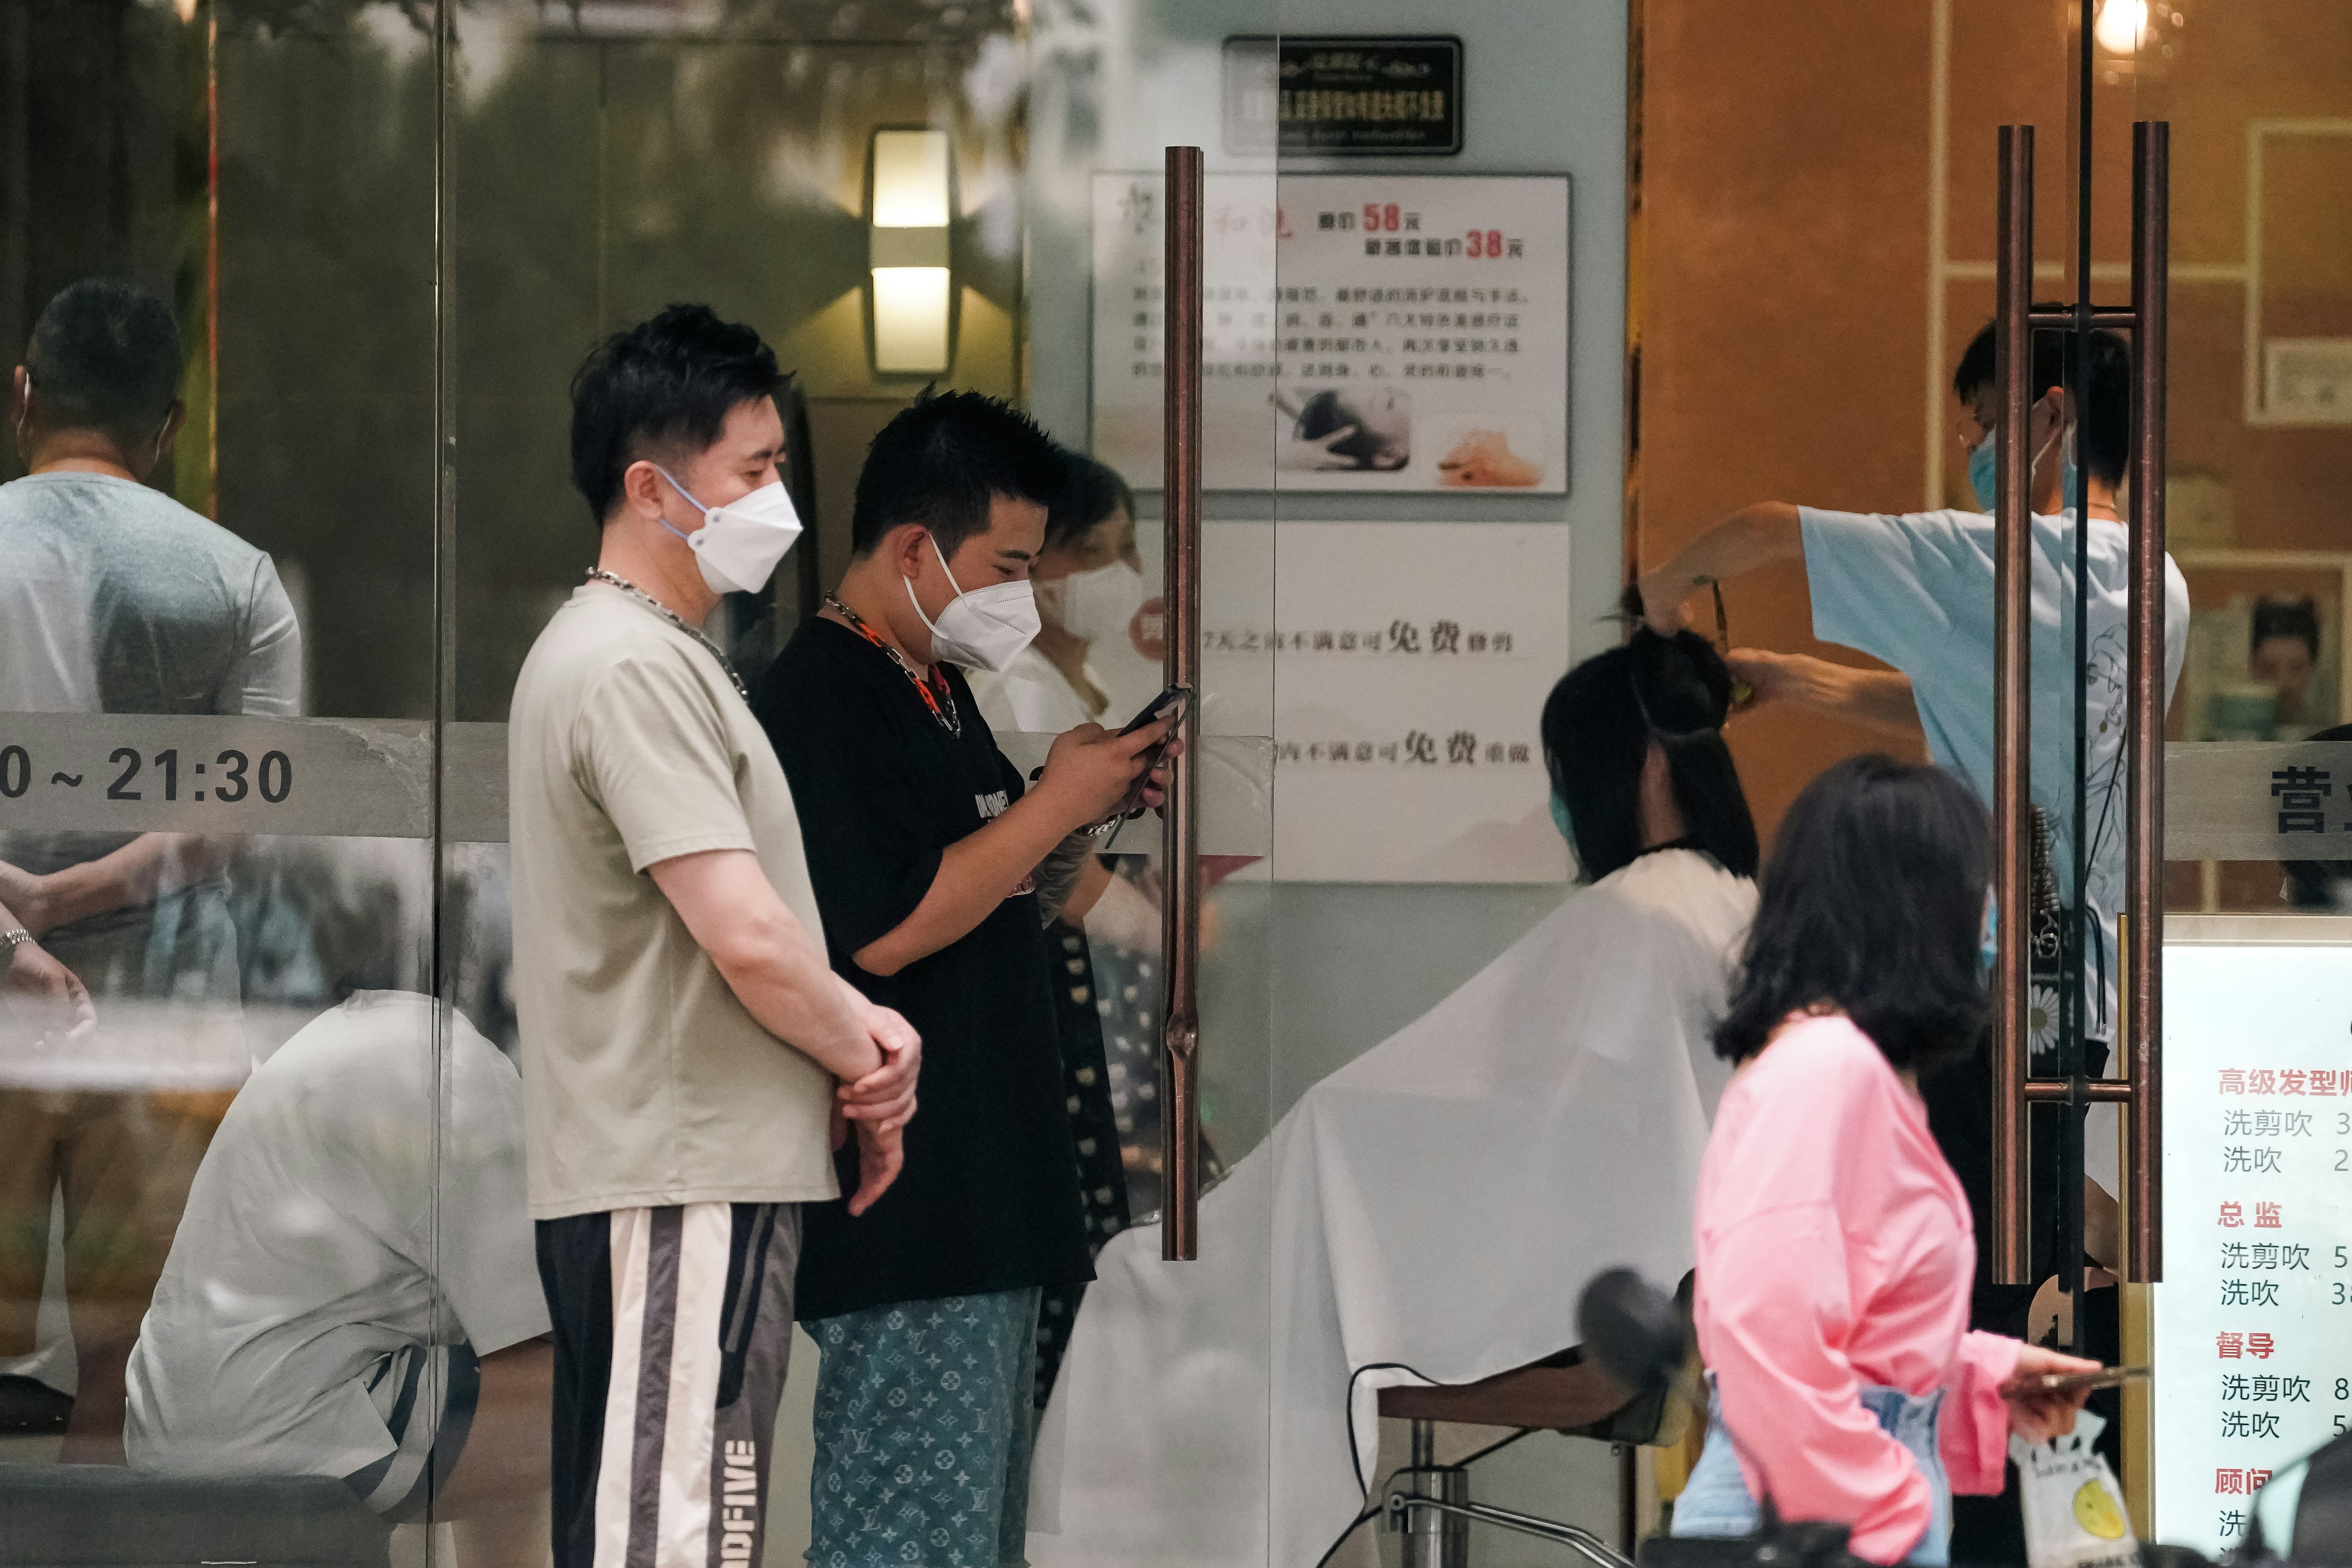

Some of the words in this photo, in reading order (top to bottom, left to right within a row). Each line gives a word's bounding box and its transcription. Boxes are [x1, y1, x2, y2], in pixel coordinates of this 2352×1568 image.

[107, 747, 292, 803] 21:30
[2224, 1109, 2313, 1138] 洗剪吹
[2337, 1112, 2351, 1135] 3
[2223, 1145, 2282, 1174] 洗吹
[2334, 1149, 2349, 1172] 2
[2221, 1241, 2310, 1271] 洗剪吹
[2334, 1246, 2348, 1268] 5
[2220, 1278, 2280, 1307] 洗吹
[2331, 1282, 2352, 1305] 3
[2216, 1331, 2275, 1360] 督导
[2222, 1373, 2311, 1403] 洗剪吹
[2334, 1377, 2350, 1401] 8
[2221, 1410, 2280, 1439] 洗吹
